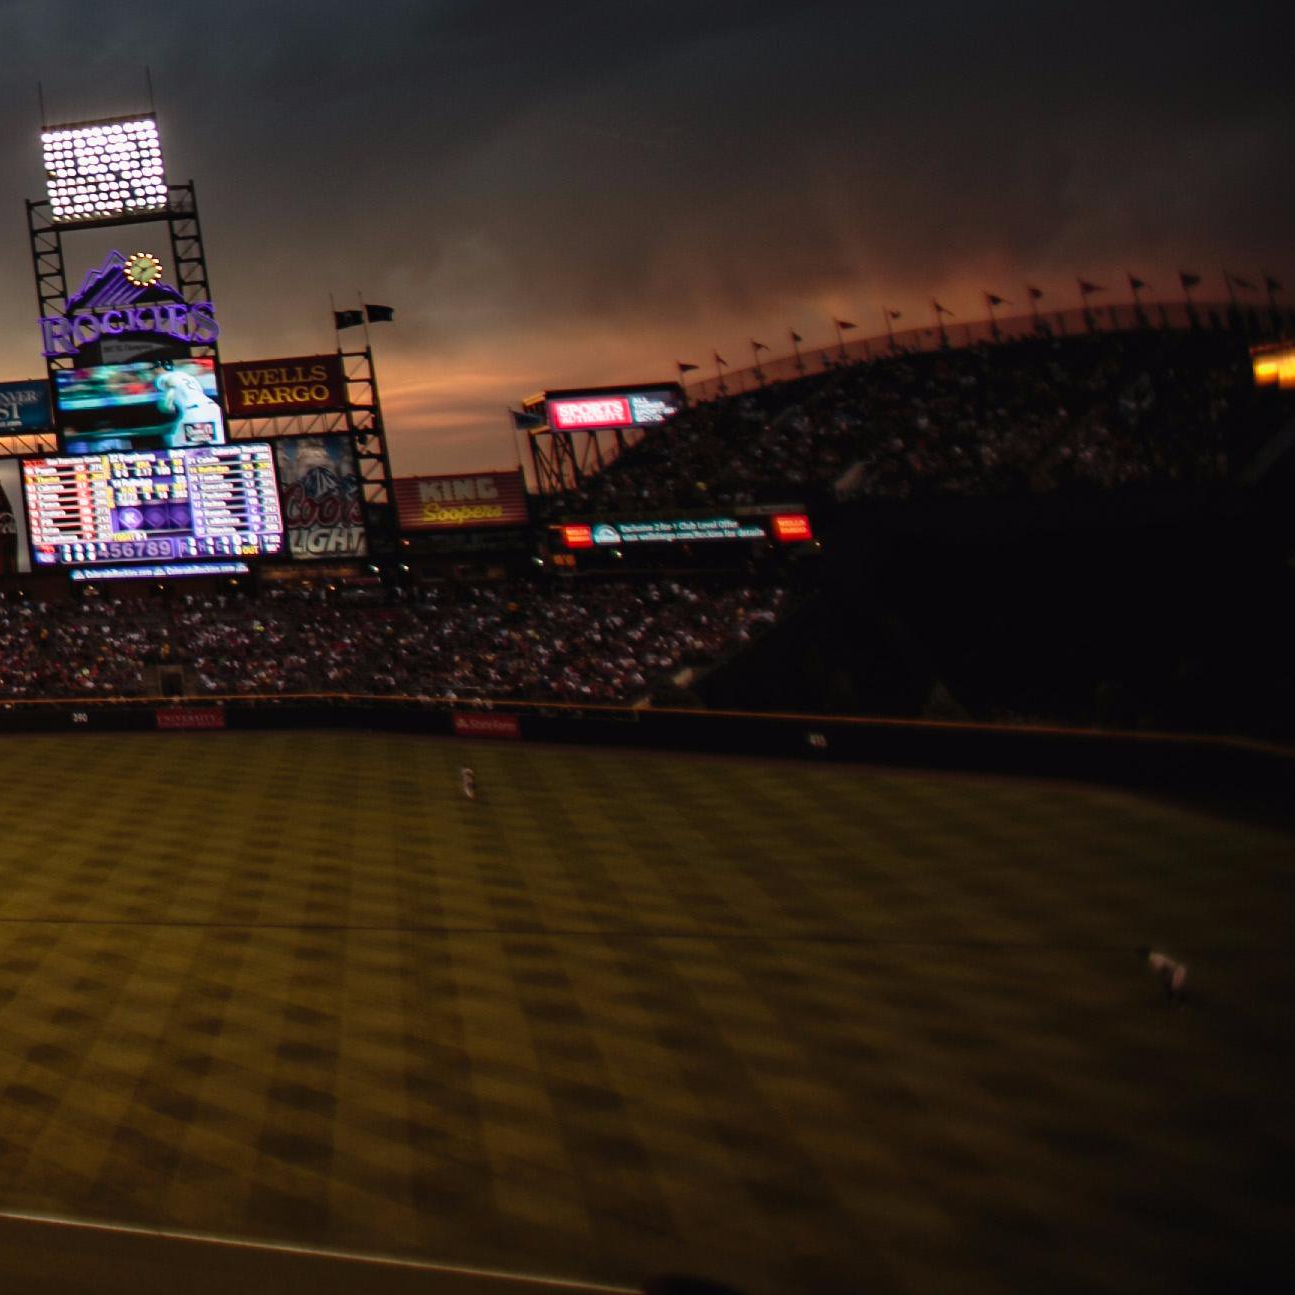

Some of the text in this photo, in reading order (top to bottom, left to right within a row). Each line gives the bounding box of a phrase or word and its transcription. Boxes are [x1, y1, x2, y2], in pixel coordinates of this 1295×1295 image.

[38, 302, 219, 357] ROCKIES
[236, 365, 327, 386] WELLS
[242, 384, 329, 406] FARGO
[559, 400, 623, 416] SPORTS
[417, 477, 499, 502] KING
[423, 501, 503, 525] Soopers
[289, 526, 367, 559] LIGHT
